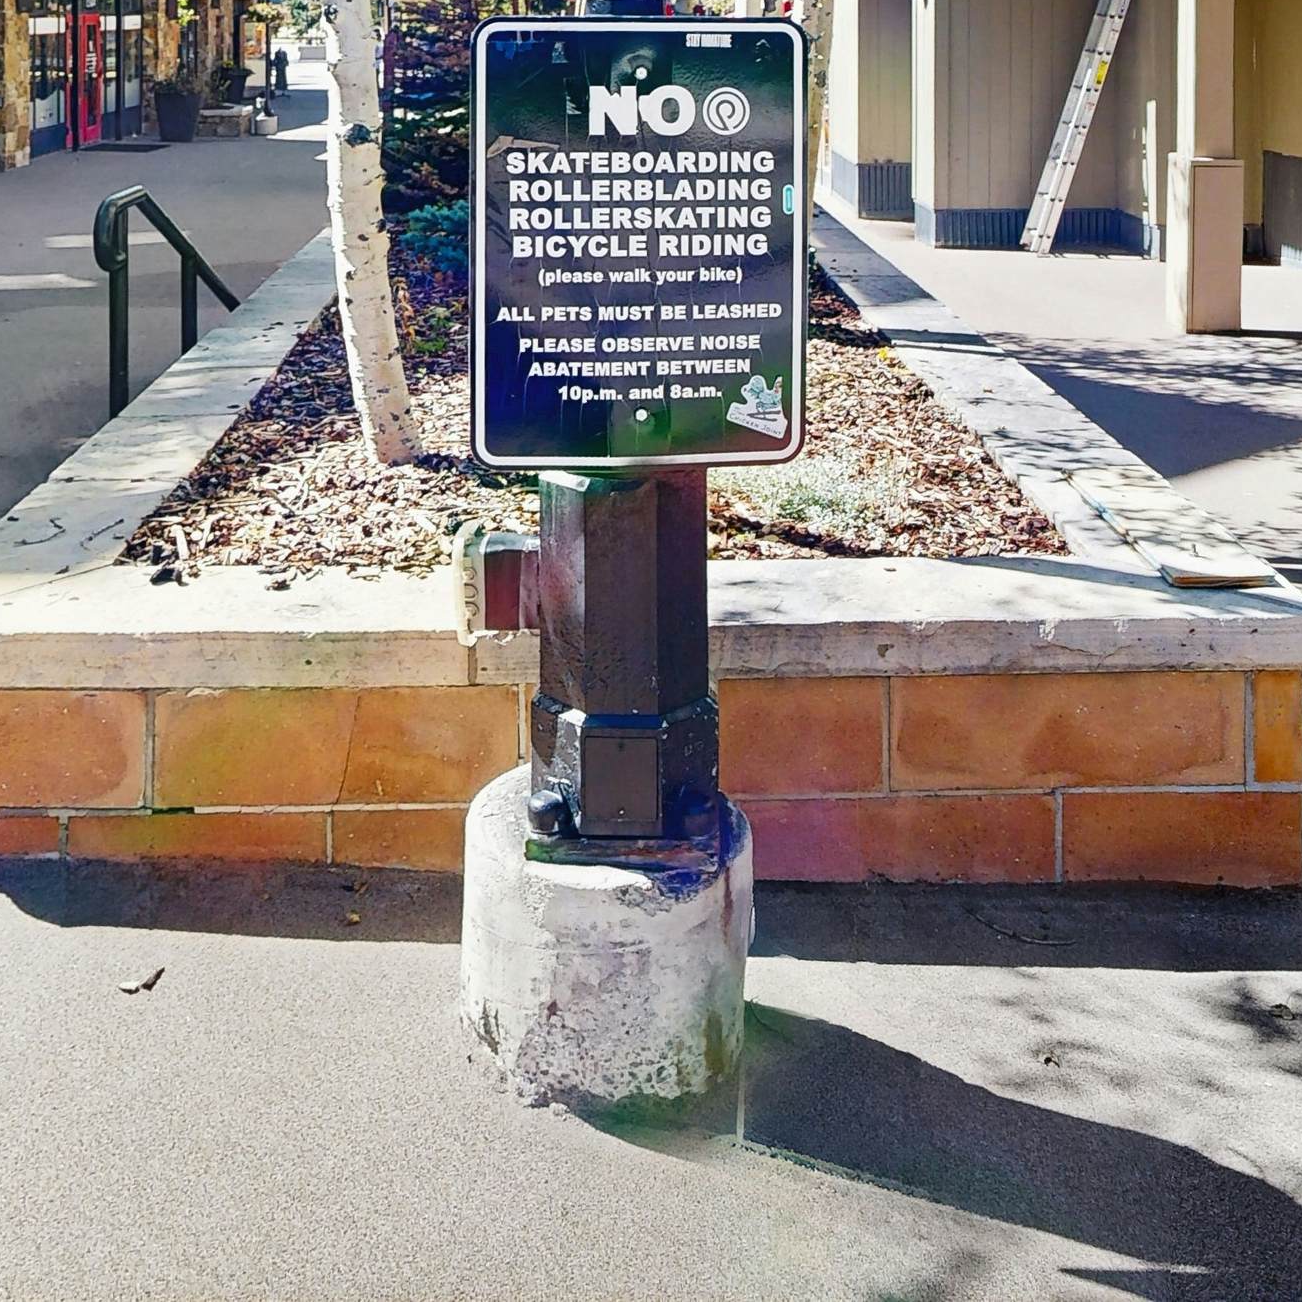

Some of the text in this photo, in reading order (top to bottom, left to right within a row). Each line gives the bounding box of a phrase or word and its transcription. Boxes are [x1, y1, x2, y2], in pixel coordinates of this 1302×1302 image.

[589, 84, 695, 136] NO
[506, 151, 775, 174] SKATEBOARDING
[509, 179, 772, 202] ROLLERBLADING
[509, 206, 772, 230] ROLLERSKATING
[513, 233, 769, 258] BICYCLE RIDING
[538, 267, 743, 287] (please walk your bike)
[497, 303, 782, 322] ALL PETS MUST BE LEASHED
[519, 334, 761, 353] PLEASE OBSERVE NOISE
[528, 359, 750, 377] ABATEMENT BETWEEN
[558, 384, 722, 403] 10p.m. and 8a.m.
